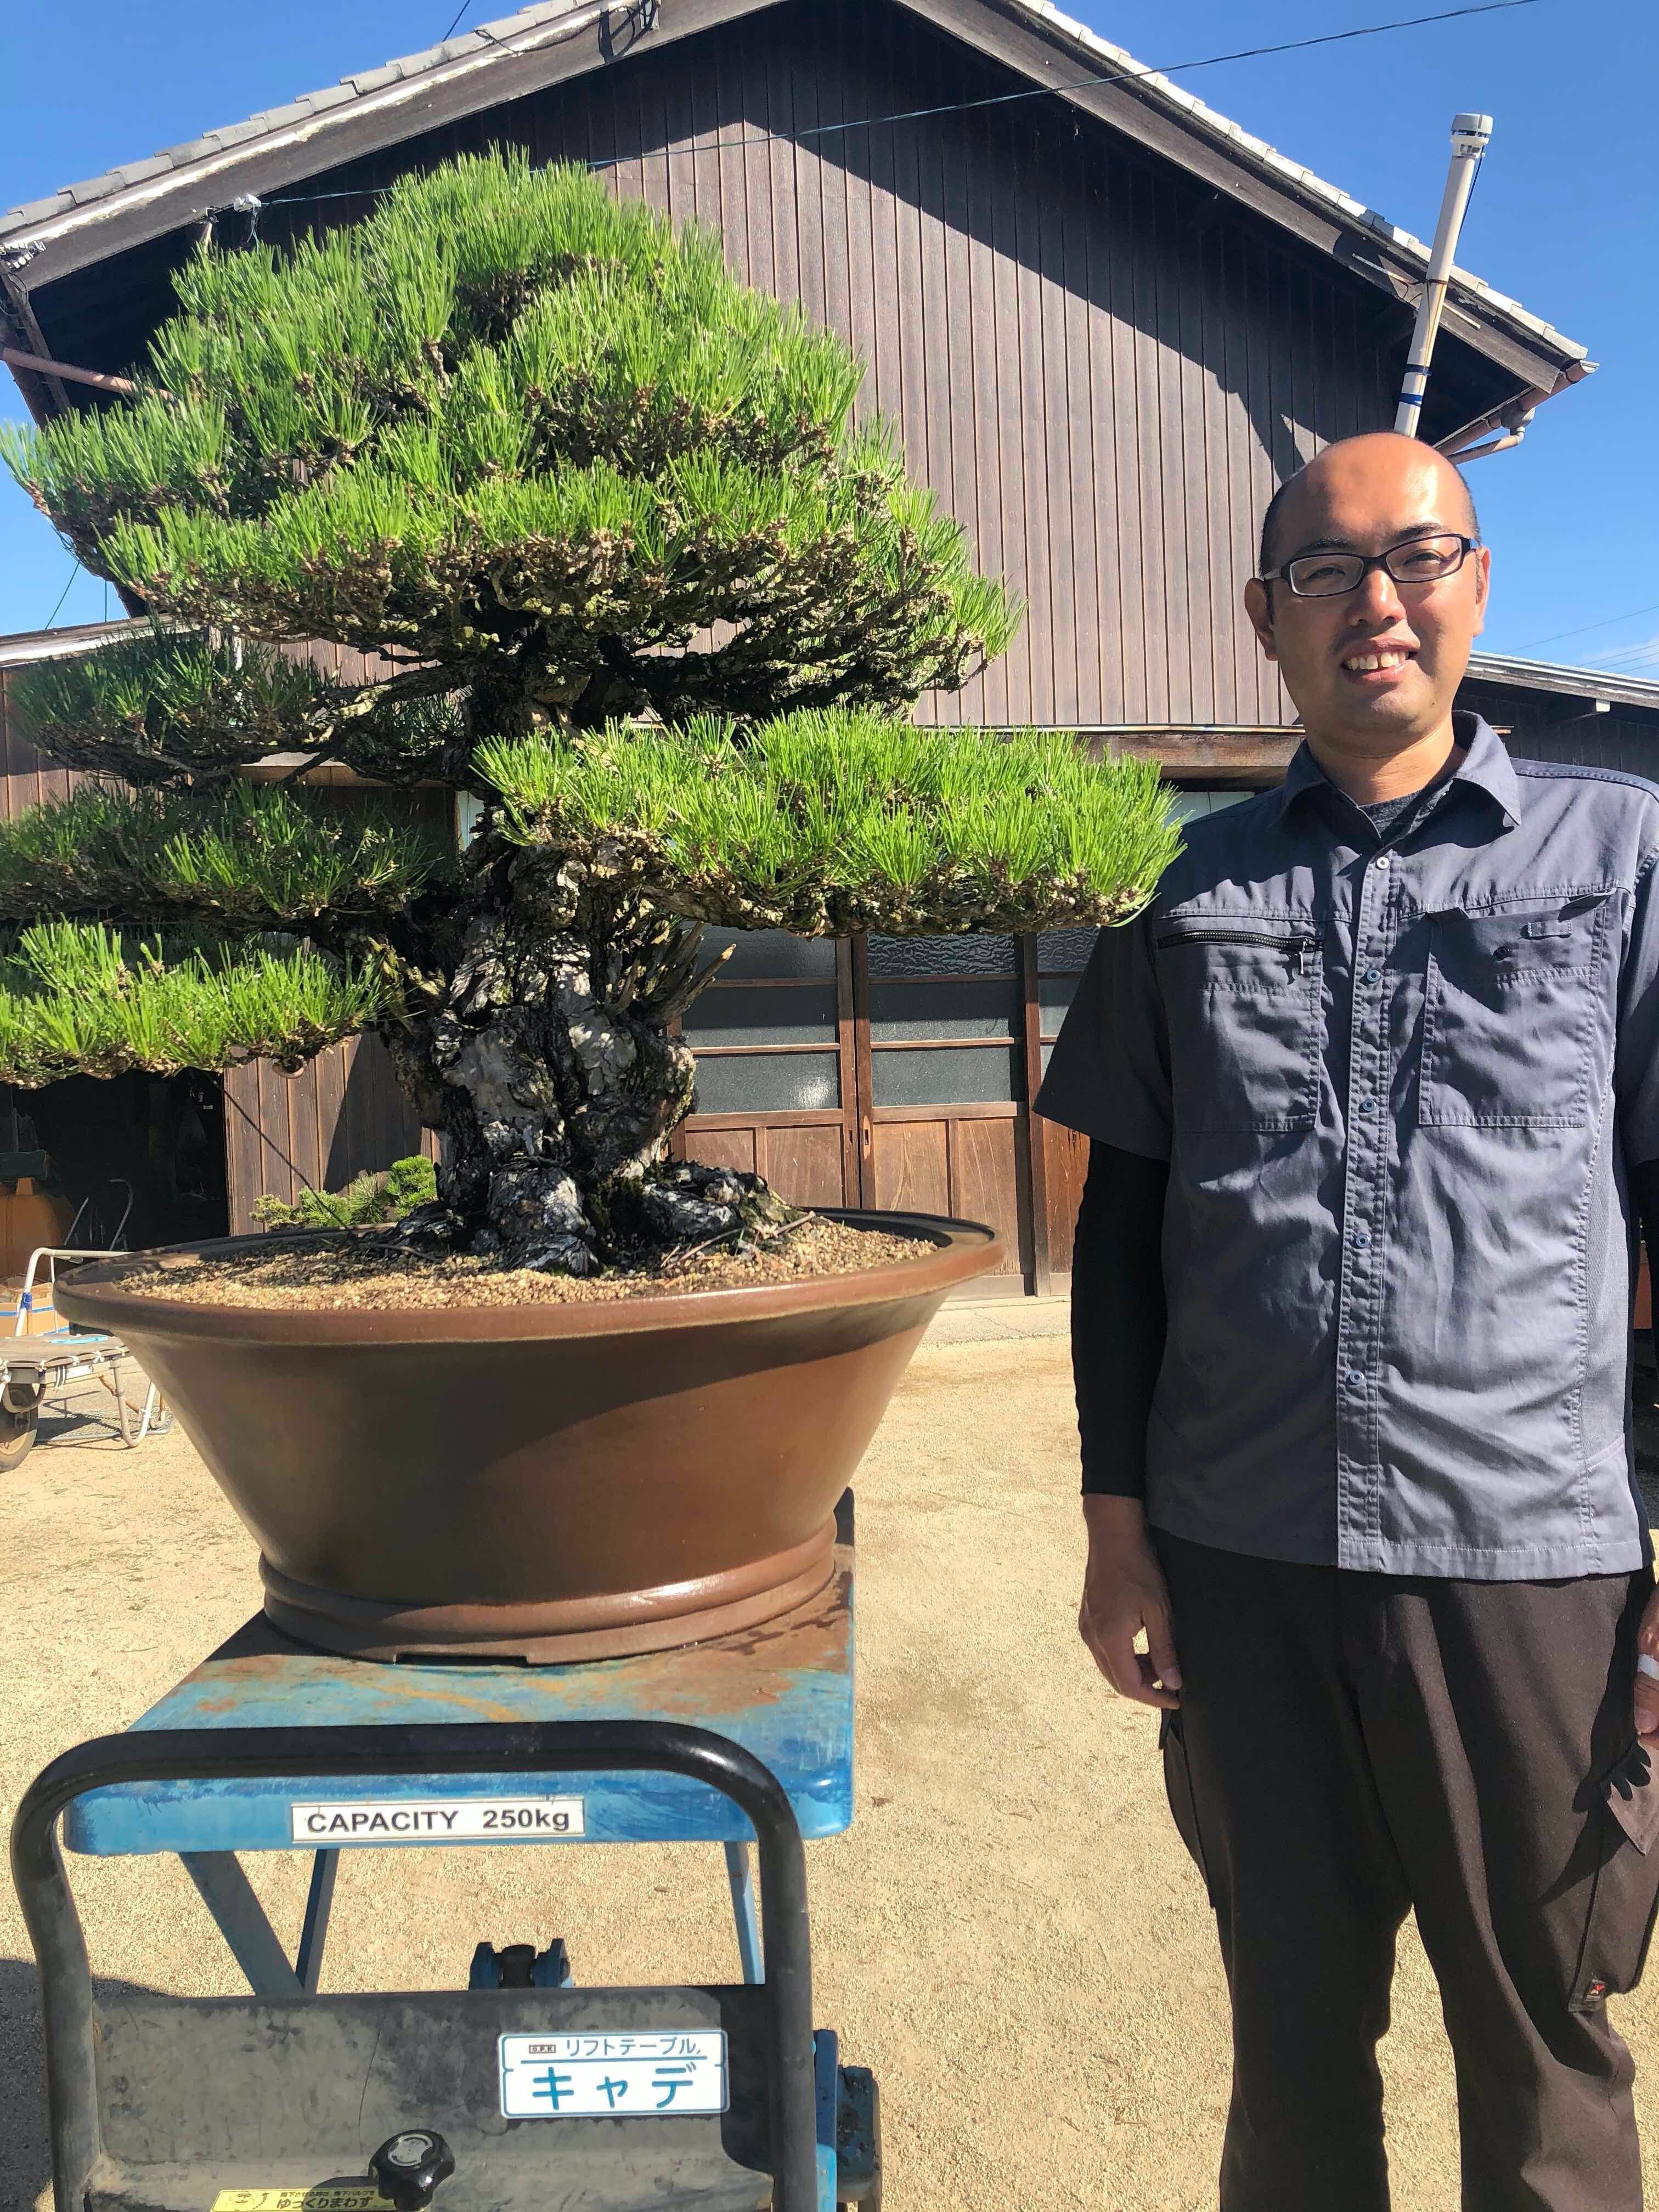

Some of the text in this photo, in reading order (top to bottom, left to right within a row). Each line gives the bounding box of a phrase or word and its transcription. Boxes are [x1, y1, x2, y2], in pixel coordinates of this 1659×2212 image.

[307, 1809, 569, 1832] CAPACITY 250kg
[567, 2036, 696, 2056] リフトテーブル
[532, 2062, 697, 2111] キャデ
